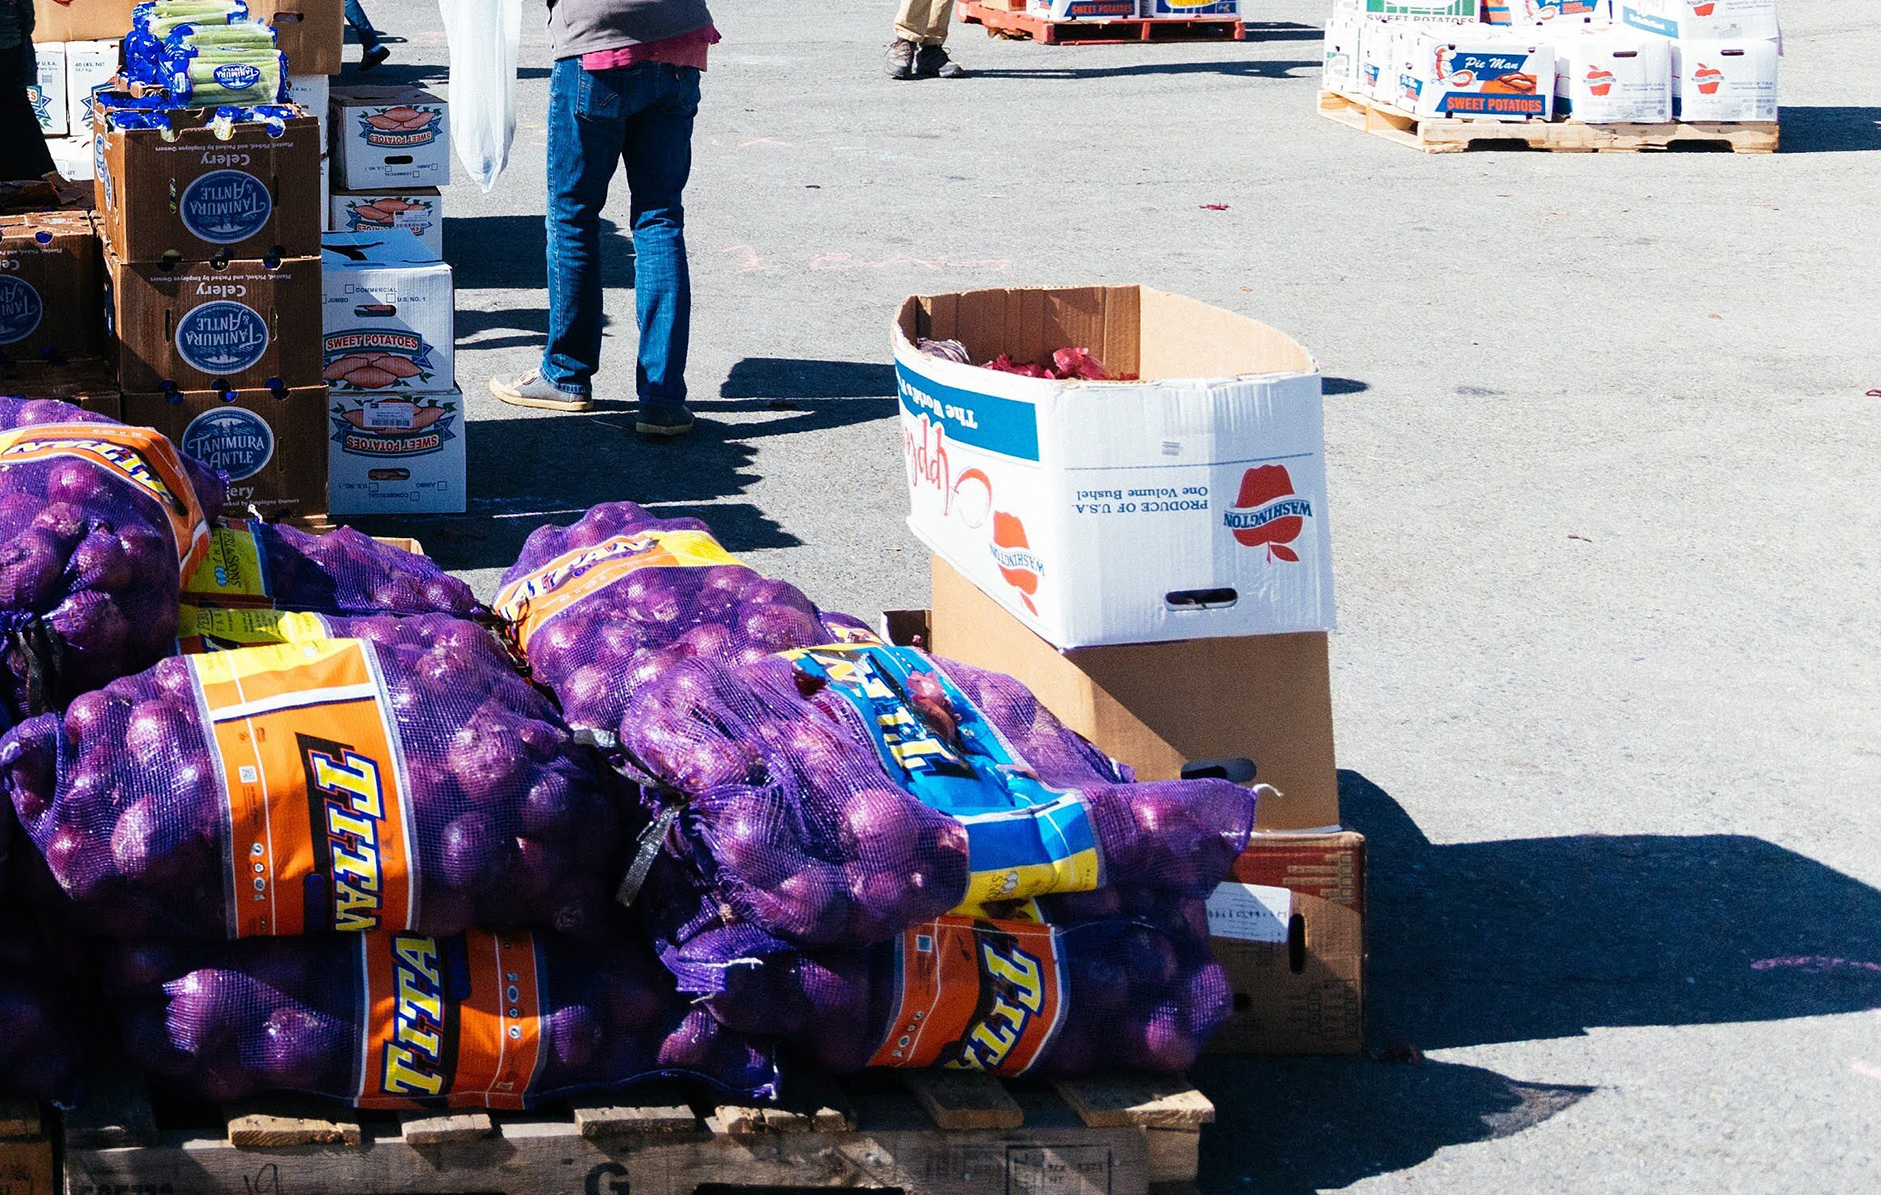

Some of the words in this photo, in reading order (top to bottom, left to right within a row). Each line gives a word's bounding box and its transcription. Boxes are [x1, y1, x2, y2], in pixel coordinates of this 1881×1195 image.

[1072, 5, 1097, 14] SWEET
[1099, 4, 1133, 13] POTATOES
[1464, 57, 1486, 69] Pie
[1488, 57, 1520, 69] Man
[214, 65, 260, 80] TANIMURA
[1447, 97, 1485, 110] SWEET
[1487, 99, 1542, 112] POTATOES
[369, 134, 407, 144] POTATOES
[409, 131, 432, 144] SWEET
[200, 152, 251, 166] Celery
[201, 178, 252, 200] ANTLE
[190, 191, 266, 217] TANIMURA
[196, 283, 247, 298] Celery
[197, 309, 249, 331] ANTLE
[242, 315, 250, 325] &
[185, 323, 264, 348] TANIMURA
[326, 335, 363, 349] SWEET
[365, 335, 418, 349] POTATOES
[944, 404, 979, 430] The
[187, 433, 265, 459] TANIMURA
[346, 436, 401, 451] POTATOES
[403, 435, 438, 450] SWEET
[209, 451, 254, 469] ANTLE
[1077, 489, 1122, 501] Bushel
[1128, 487, 1177, 498] Volume
[1182, 486, 1209, 496] One
[1072, 504, 1111, 514] U.S.A.
[1118, 502, 1136, 513] OF
[1141, 500, 1209, 512] PRODUCE
[1223, 502, 1313, 528] WASHINGTON
[989, 543, 1046, 576] WASHINGTON
[227, 555, 241, 589] SONS
[385, 936, 443, 1095] TITA
